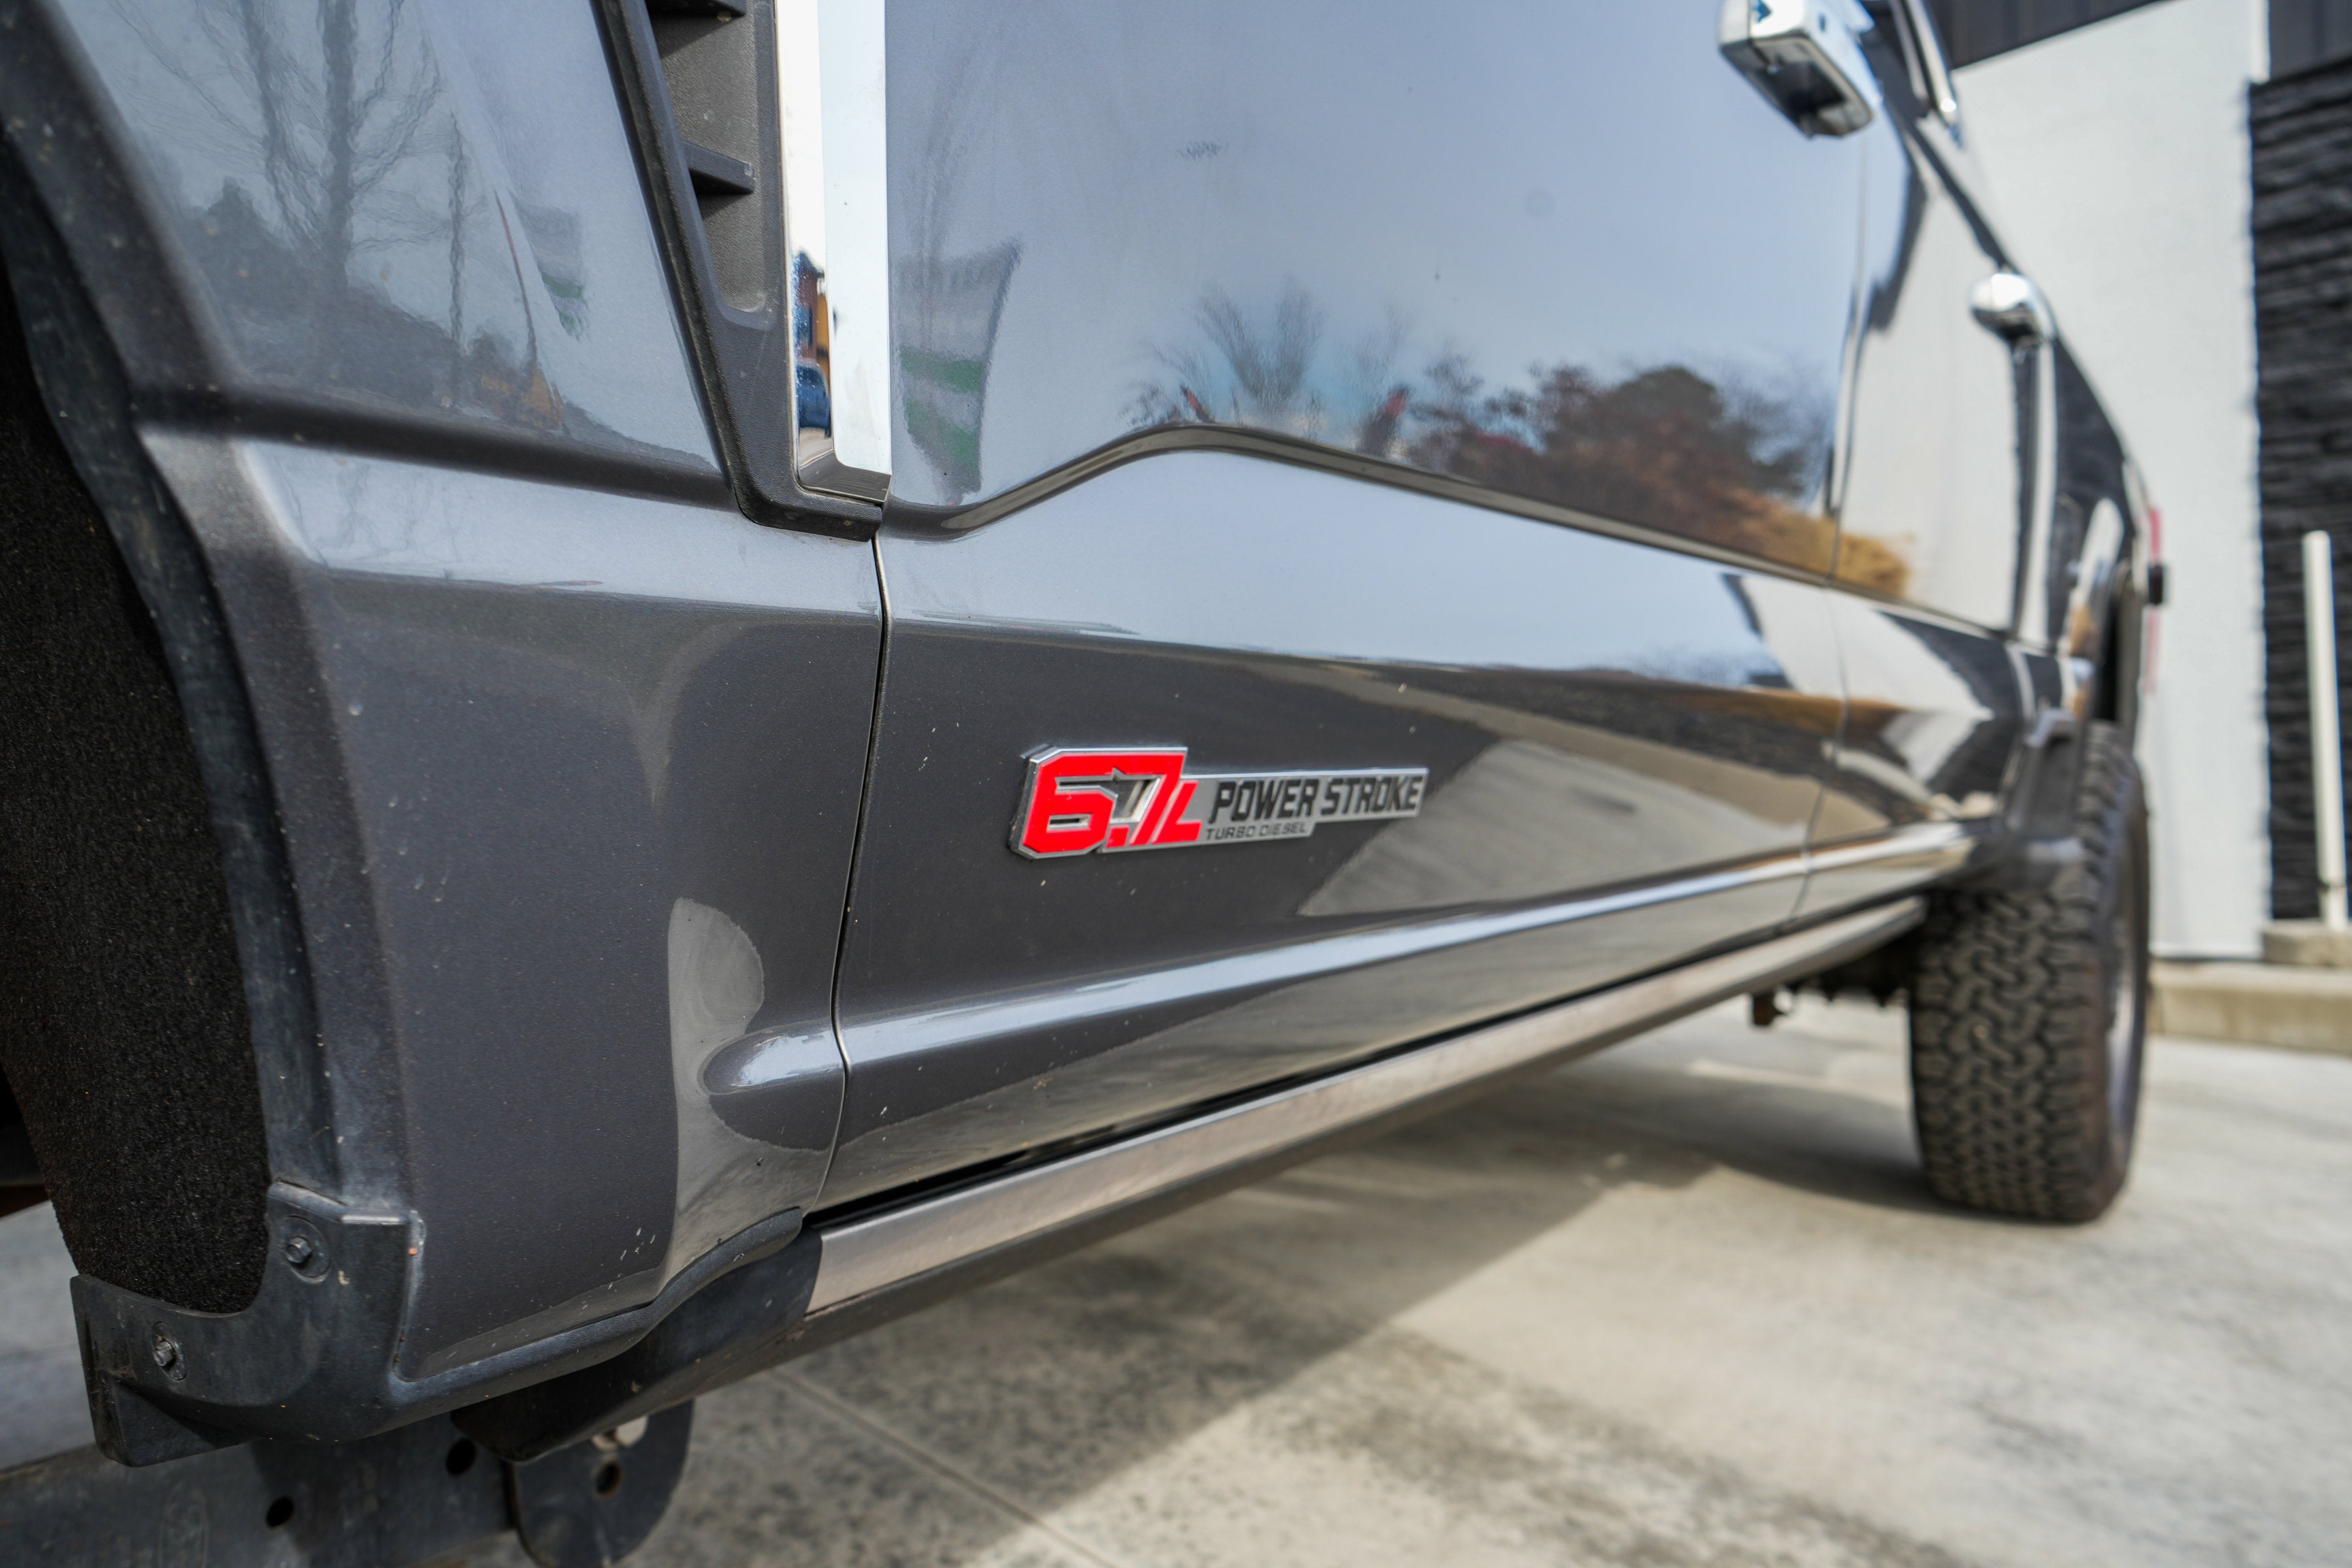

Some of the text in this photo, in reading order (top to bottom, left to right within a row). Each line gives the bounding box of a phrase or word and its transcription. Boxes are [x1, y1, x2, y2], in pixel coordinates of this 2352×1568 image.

[1022, 751, 1202, 853] 6.7L
[1209, 776, 1423, 824] POWER STROKE
[1206, 819, 1307, 840] TURBO DIESEL
